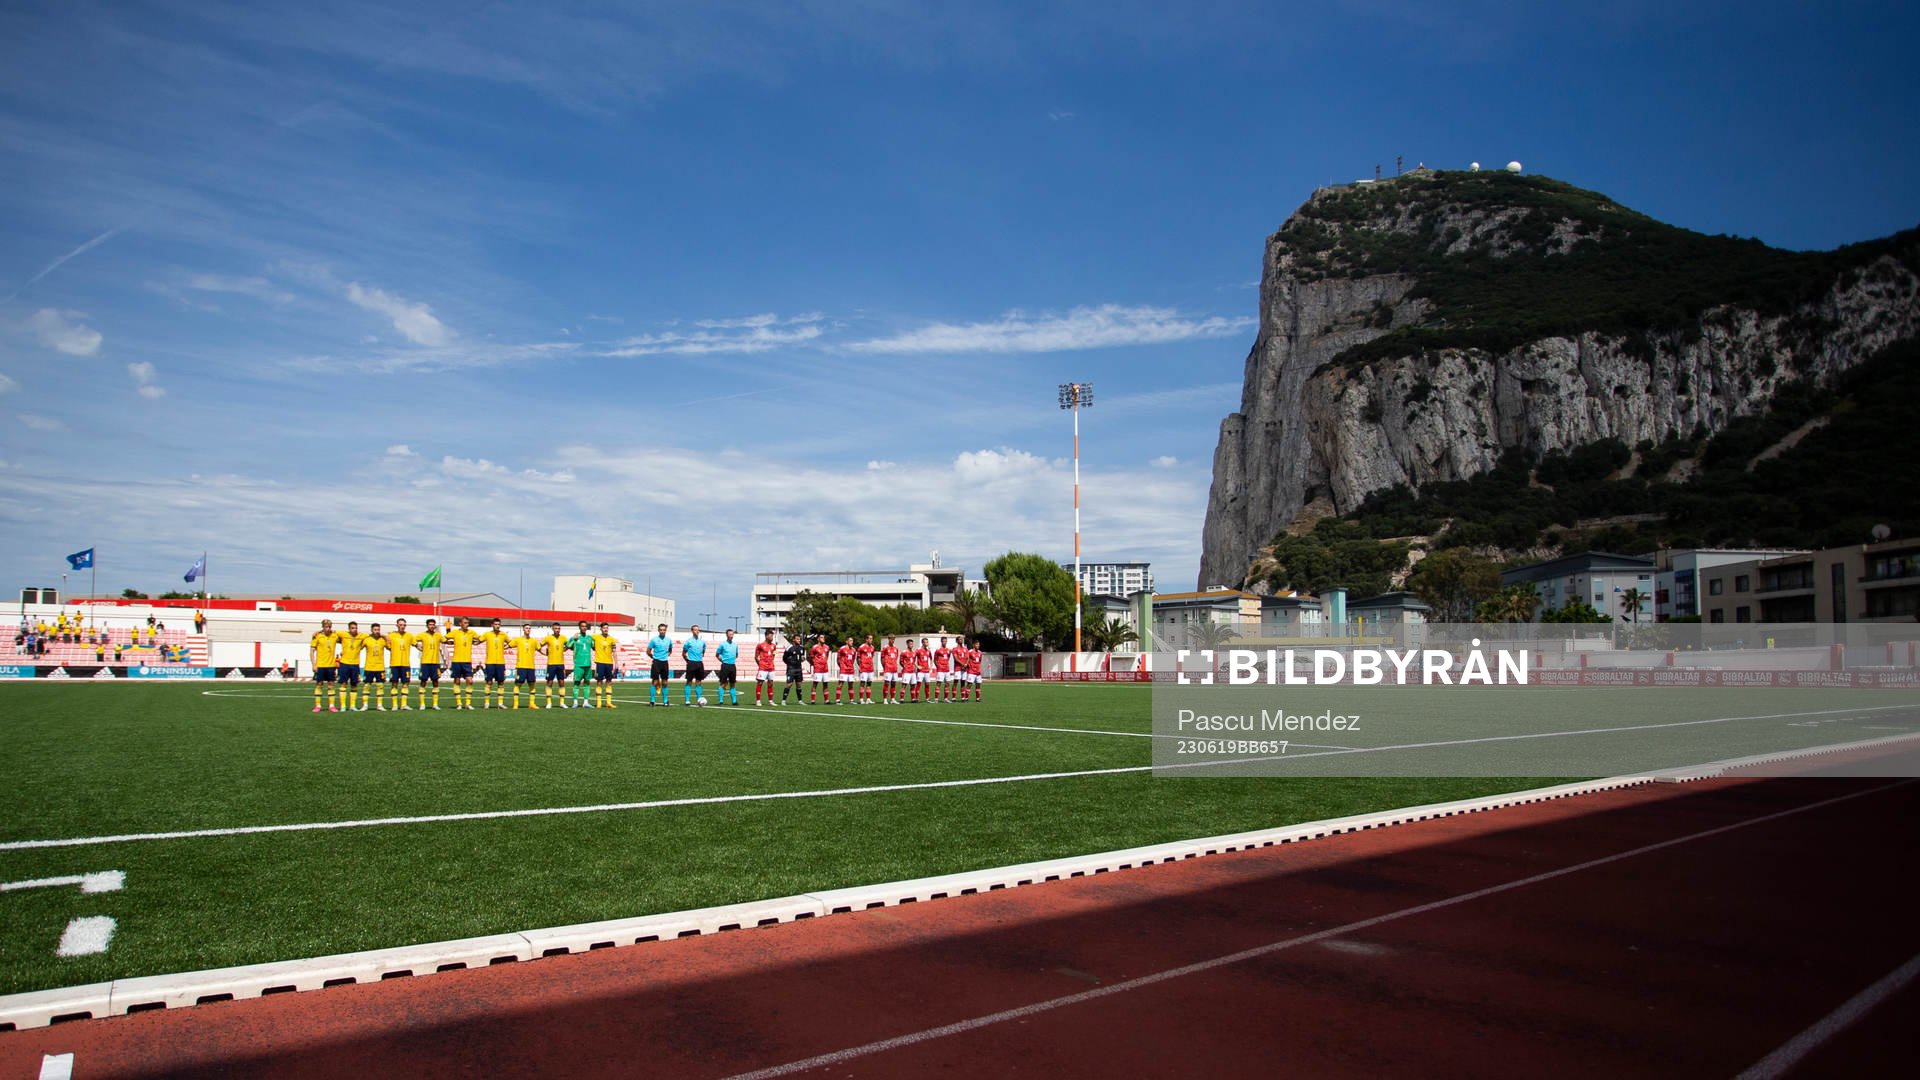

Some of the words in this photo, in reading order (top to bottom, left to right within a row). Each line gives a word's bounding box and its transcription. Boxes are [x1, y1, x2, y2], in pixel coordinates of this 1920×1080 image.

[344, 602, 373, 610] CEPSA
[150, 667, 202, 675] PENINSULA
[1540, 672, 1579, 681] GIBRALTAR
[1591, 672, 1634, 681] GIBRALTAR
[1654, 672, 1700, 681] GIBRALTAR
[1721, 672, 1772, 682] GIBRALTAR
[1797, 672, 1851, 682] GIBRALTAR
[1879, 672, 1920, 683] GIBRAL
